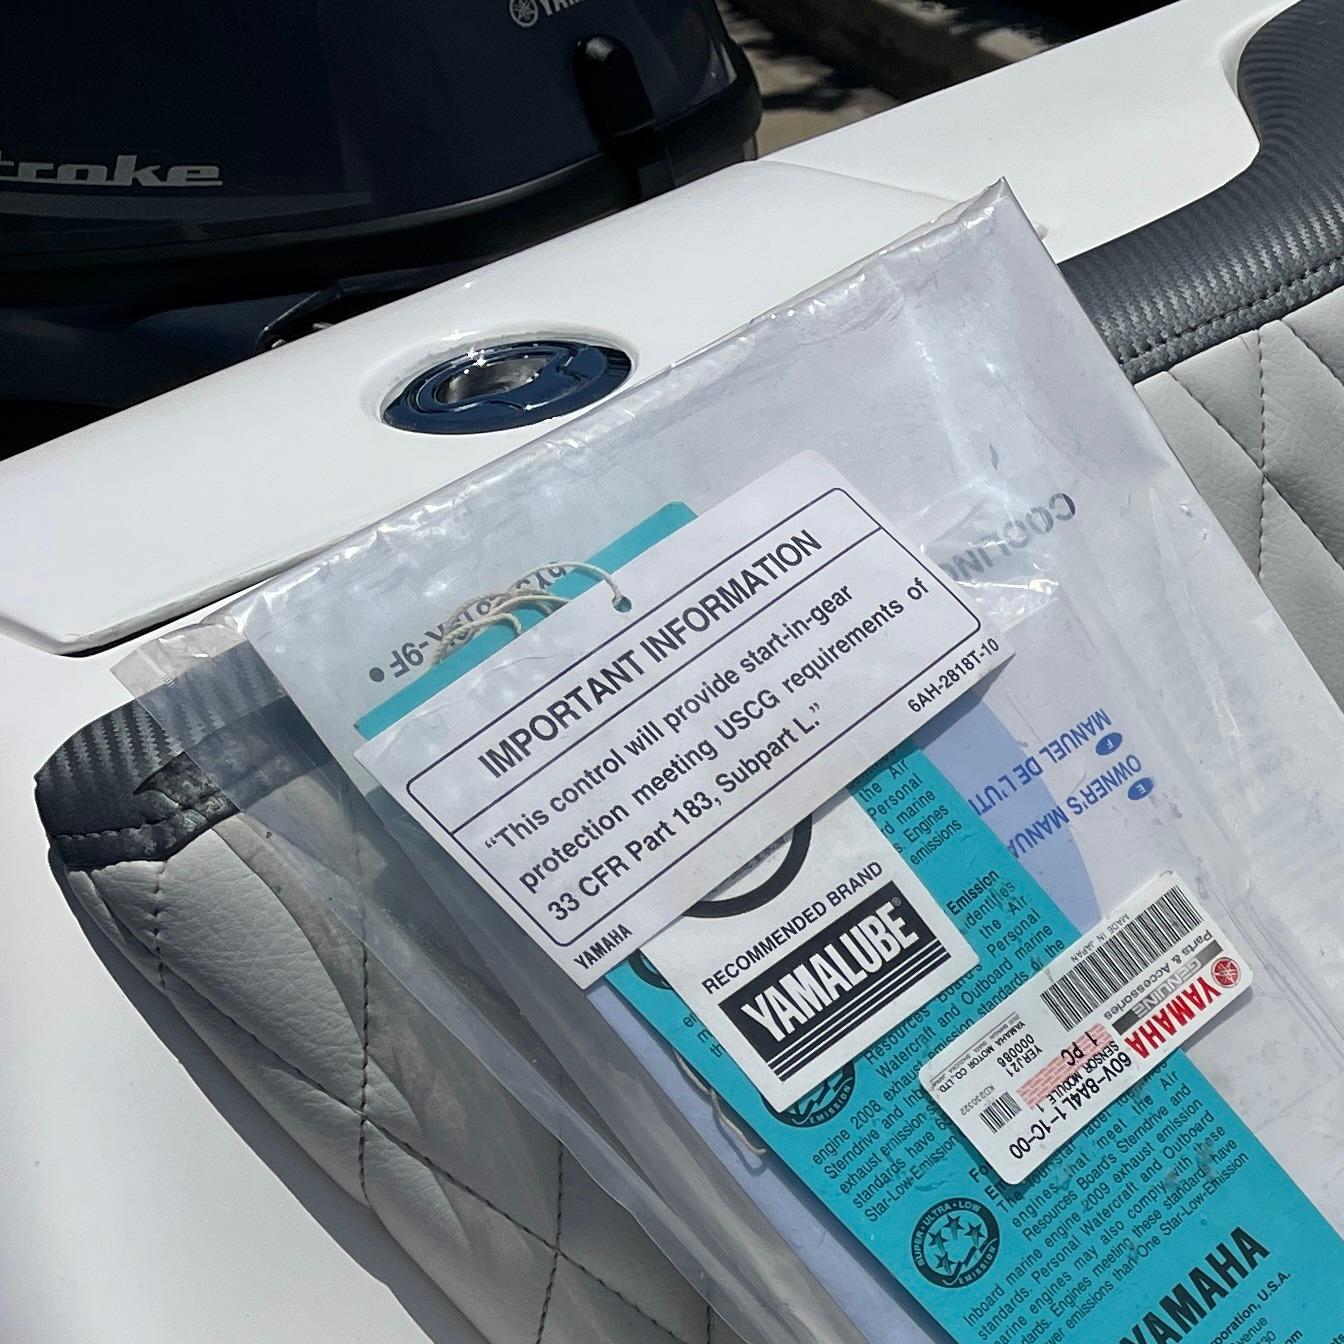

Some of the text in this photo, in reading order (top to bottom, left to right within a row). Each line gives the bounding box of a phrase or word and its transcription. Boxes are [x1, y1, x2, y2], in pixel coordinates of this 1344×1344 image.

[0, 151, 223, 186] roke
[478, 649, 645, 778] IMPORTANT
[640, 529, 822, 663] INFORMATION
[908, 638, 999, 712] 6AH-2818T-10
[485, 585, 852, 849] “This control will provide start-in-gear
[519, 805, 630, 894] protection
[631, 739, 718, 806] meeting
[714, 689, 781, 740] USCG
[782, 600, 904, 693] requirements
[907, 577, 929, 600] of
[857, 780, 882, 803] the
[886, 757, 909, 780] Air
[866, 772, 923, 822] Personal
[967, 708, 1112, 817] MANUEL DE L'UTI
[548, 892, 580, 920] 33
[578, 855, 630, 897] CFR
[624, 820, 677, 862] Part
[672, 791, 722, 825] 183,
[715, 727, 799, 793] Subpart
[896, 790, 936, 825] marine
[902, 805, 949, 844] Engines
[910, 820, 962, 865] emissions
[1006, 754, 1142, 859] OWNER'S MANUA
[701, 901, 827, 994] RECOMMENDED
[826, 862, 882, 907] BRAND
[946, 870, 1000, 916] Emission
[978, 895, 1028, 939] the Air
[574, 924, 633, 969] YAMAHA
[740, 901, 919, 1042] YAMALUBE
[1070, 913, 1130, 963] MADE IN JAPAN
[1103, 929, 1213, 1020] Parts & Accessories
[863, 1005, 931, 1065] Resources
[986, 908, 1041, 959] Personal
[875, 1025, 937, 1079] Watercraft
[937, 1003, 961, 1028] and
[961, 957, 1014, 1005] Outboard
[1014, 925, 1053, 961] marine
[1124, 976, 1222, 1059] YAMAHA
[1130, 957, 1206, 1018] GENUINE
[813, 1129, 851, 1165] engine
[850, 1099, 883, 1130] 2008
[976, 971, 1029, 1017] standards
[1043, 939, 1065, 958] the
[967, 1045, 995, 1069] MOTOR
[994, 1021, 1026, 1046] YAMAHA
[1061, 1031, 1098, 1066] 1 PC
[809, 1085, 852, 1124] EMISSION
[1035, 1040, 1119, 1113] SENSOR MODULE 1
[824, 1104, 904, 1179] Sterndrive and
[840, 1113, 927, 1194] exhaust emission
[853, 1131, 935, 1209] standards have
[864, 1132, 965, 1222] Star-Low-Emission
[1012, 1183, 1061, 1228] engines
[1094, 1118, 1128, 1149] meet
[1130, 1095, 1154, 1116] the
[1160, 1070, 1179, 1092] Air
[1022, 1082, 1192, 1242] Resources Board's Sterndrive and
[914, 1200, 982, 1267] SUPER ULTRA LOW
[962, 1099, 1204, 1327] Inboard marine engine 2009 exhaust emission
[978, 1109, 1215, 1341] standards. Personal Watercraft and Outboard
[1029, 1271, 1072, 1314] engines
[1073, 1245, 1098, 1271] may
[1100, 1220, 1125, 1245] also
[1127, 1180, 1168, 1219] comply
[1049, 1277, 1092, 1318] Engines
[1092, 1237, 1135, 1277] meeting
[1131, 1209, 1162, 1238] these
[1209, 1139, 1237, 1165] have
[1066, 1280, 1114, 1330] emissions
[1112, 1255, 1138, 1282] than
[1135, 1235, 1161, 1258] One
[1159, 1153, 1249, 1236] Star-Low-Emission
[959, 1245, 997, 1284] EMISSION
[1257, 1272, 1291, 1301] U.S.A.
